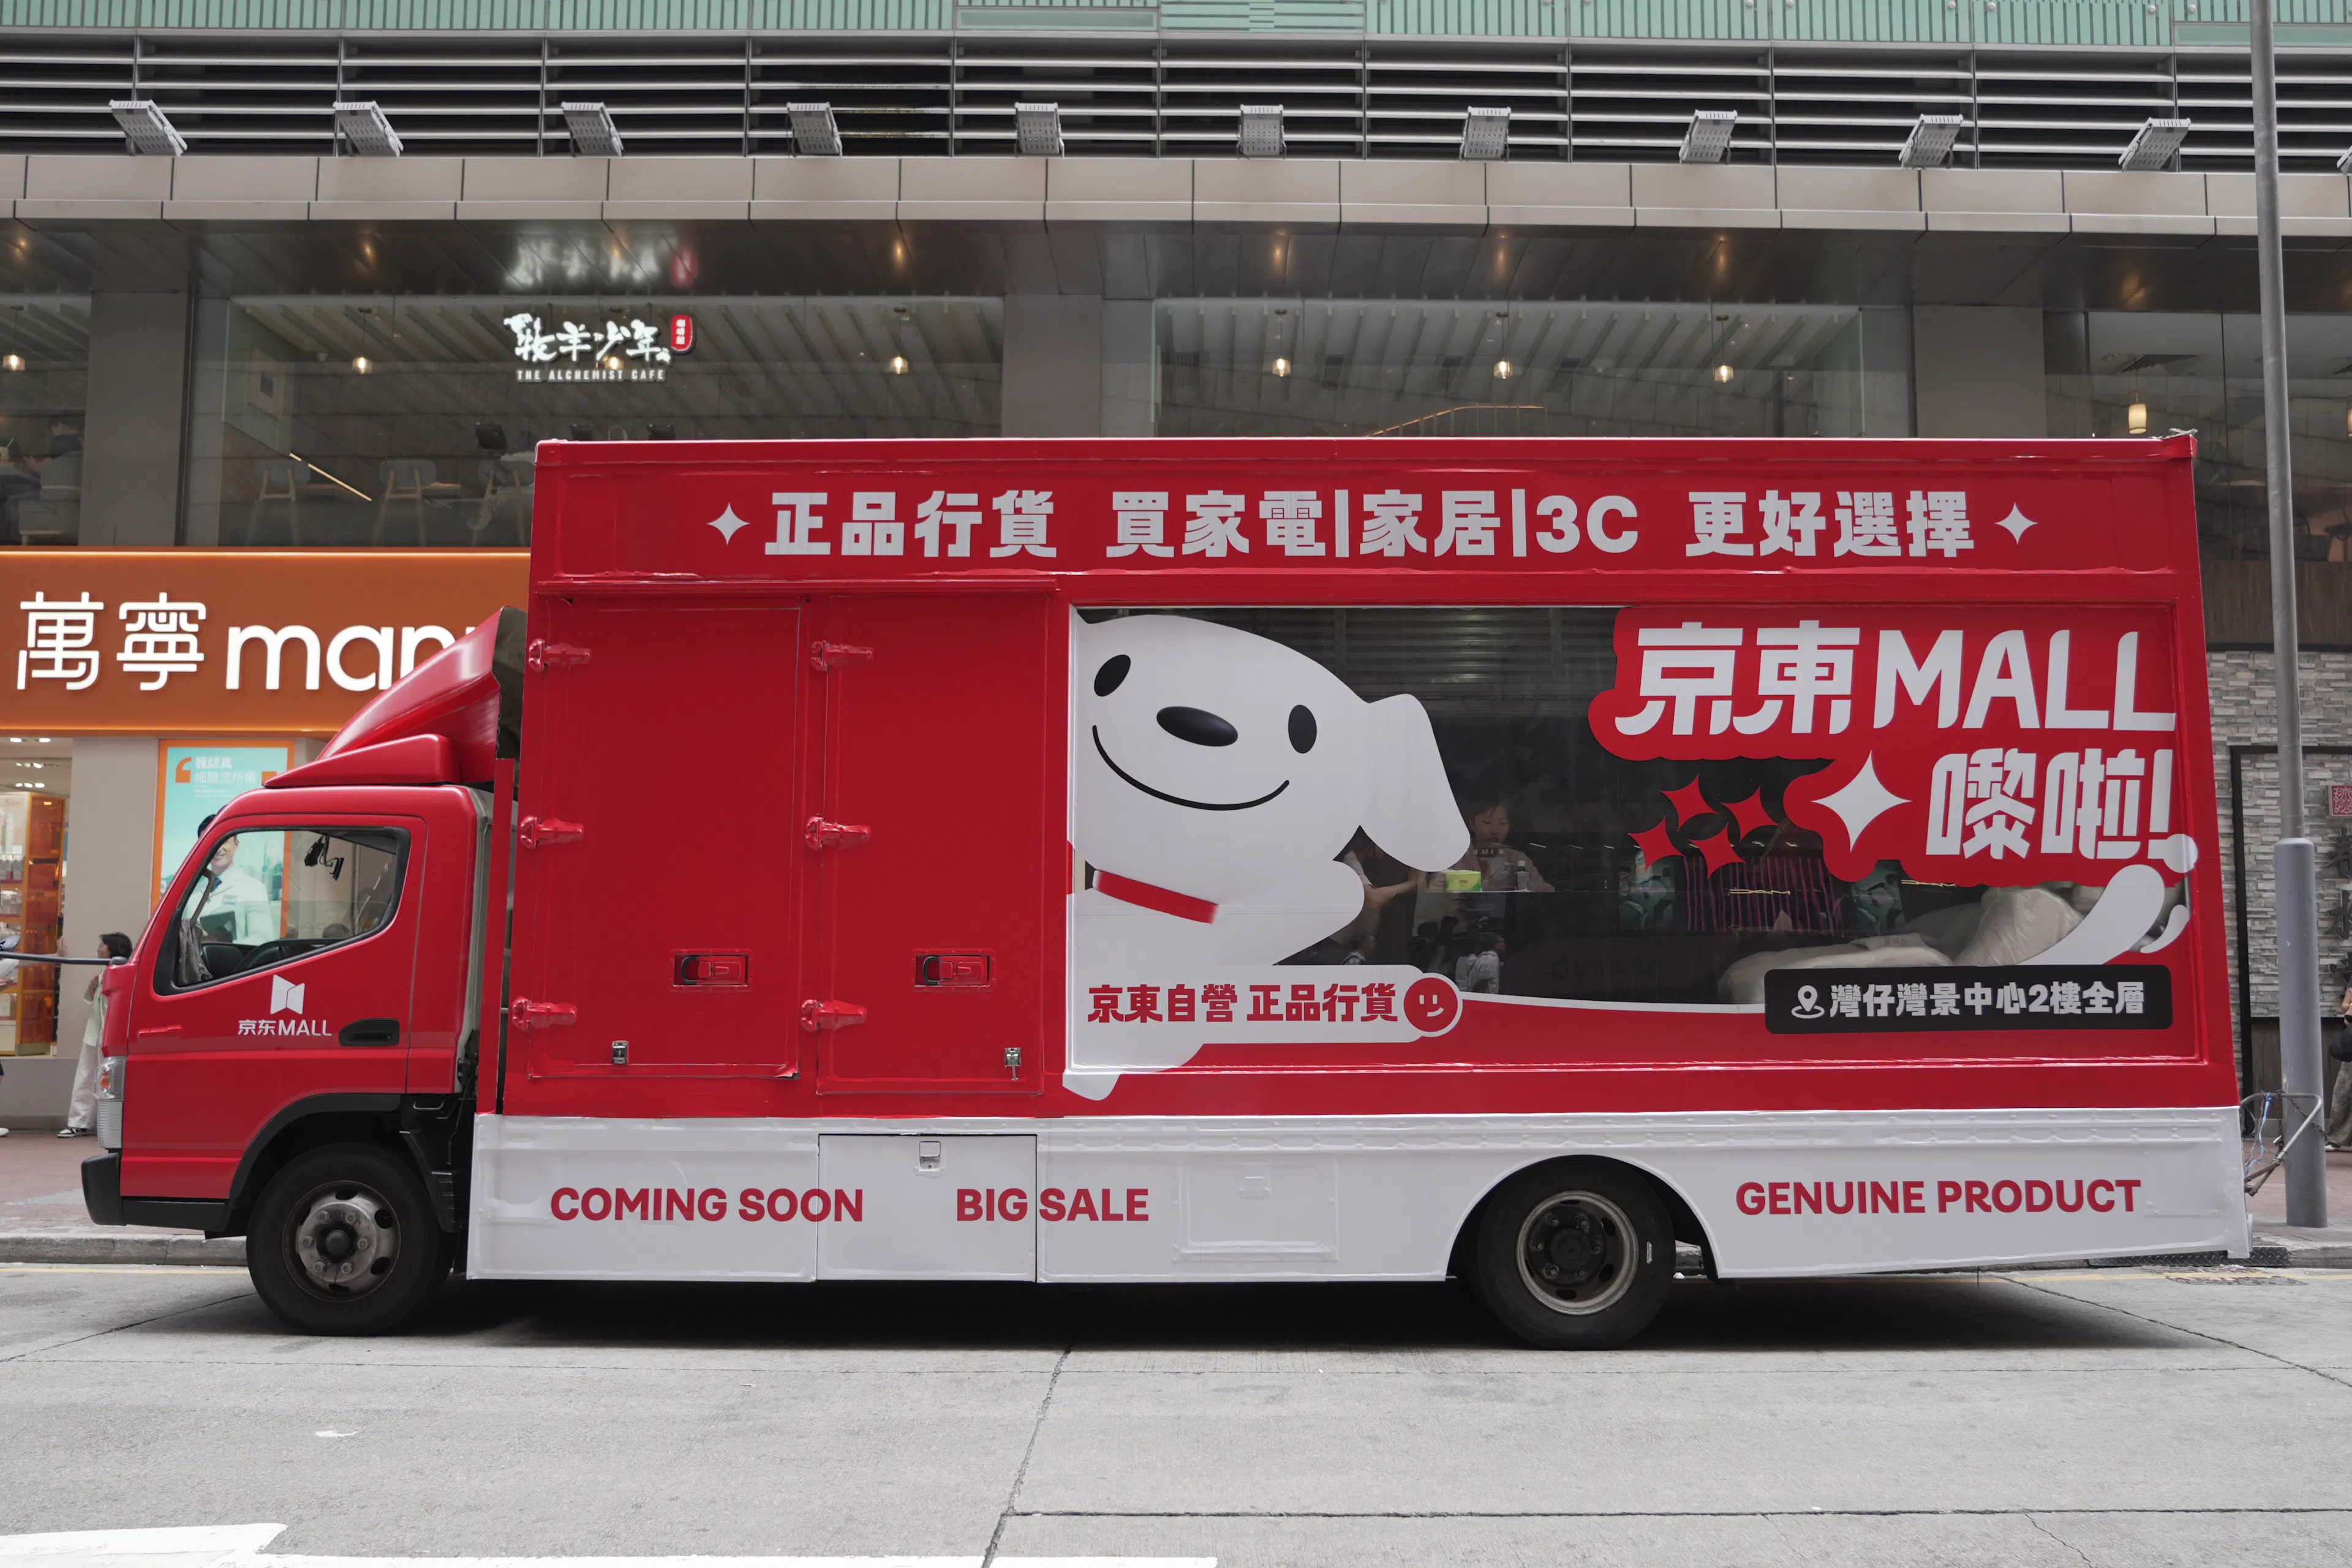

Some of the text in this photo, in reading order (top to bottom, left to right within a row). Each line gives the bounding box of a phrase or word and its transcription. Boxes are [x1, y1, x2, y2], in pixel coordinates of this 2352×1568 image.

[517, 370, 665, 380] THE ALCHEMIST CAFE
[765, 489, 1057, 558] 正品行貨
[1686, 489, 1974, 558] 更好選擇
[17, 591, 207, 691] 萬寧
[226, 625, 478, 692] man
[1615, 620, 2176, 736] 京東MALL
[1926, 747, 2174, 860] 嚟啦!
[1088, 982, 1398, 1023] 京東自營 正品行貨
[1829, 981, 2145, 1018] 灣仔灣景中心2樓全層
[238, 1019, 333, 1036] 京东MALL
[551, 1188, 863, 1222] COMING SOON
[957, 1188, 1149, 1222] BIG SALE
[1736, 1179, 2141, 1216] GENUINE PRODUCT
